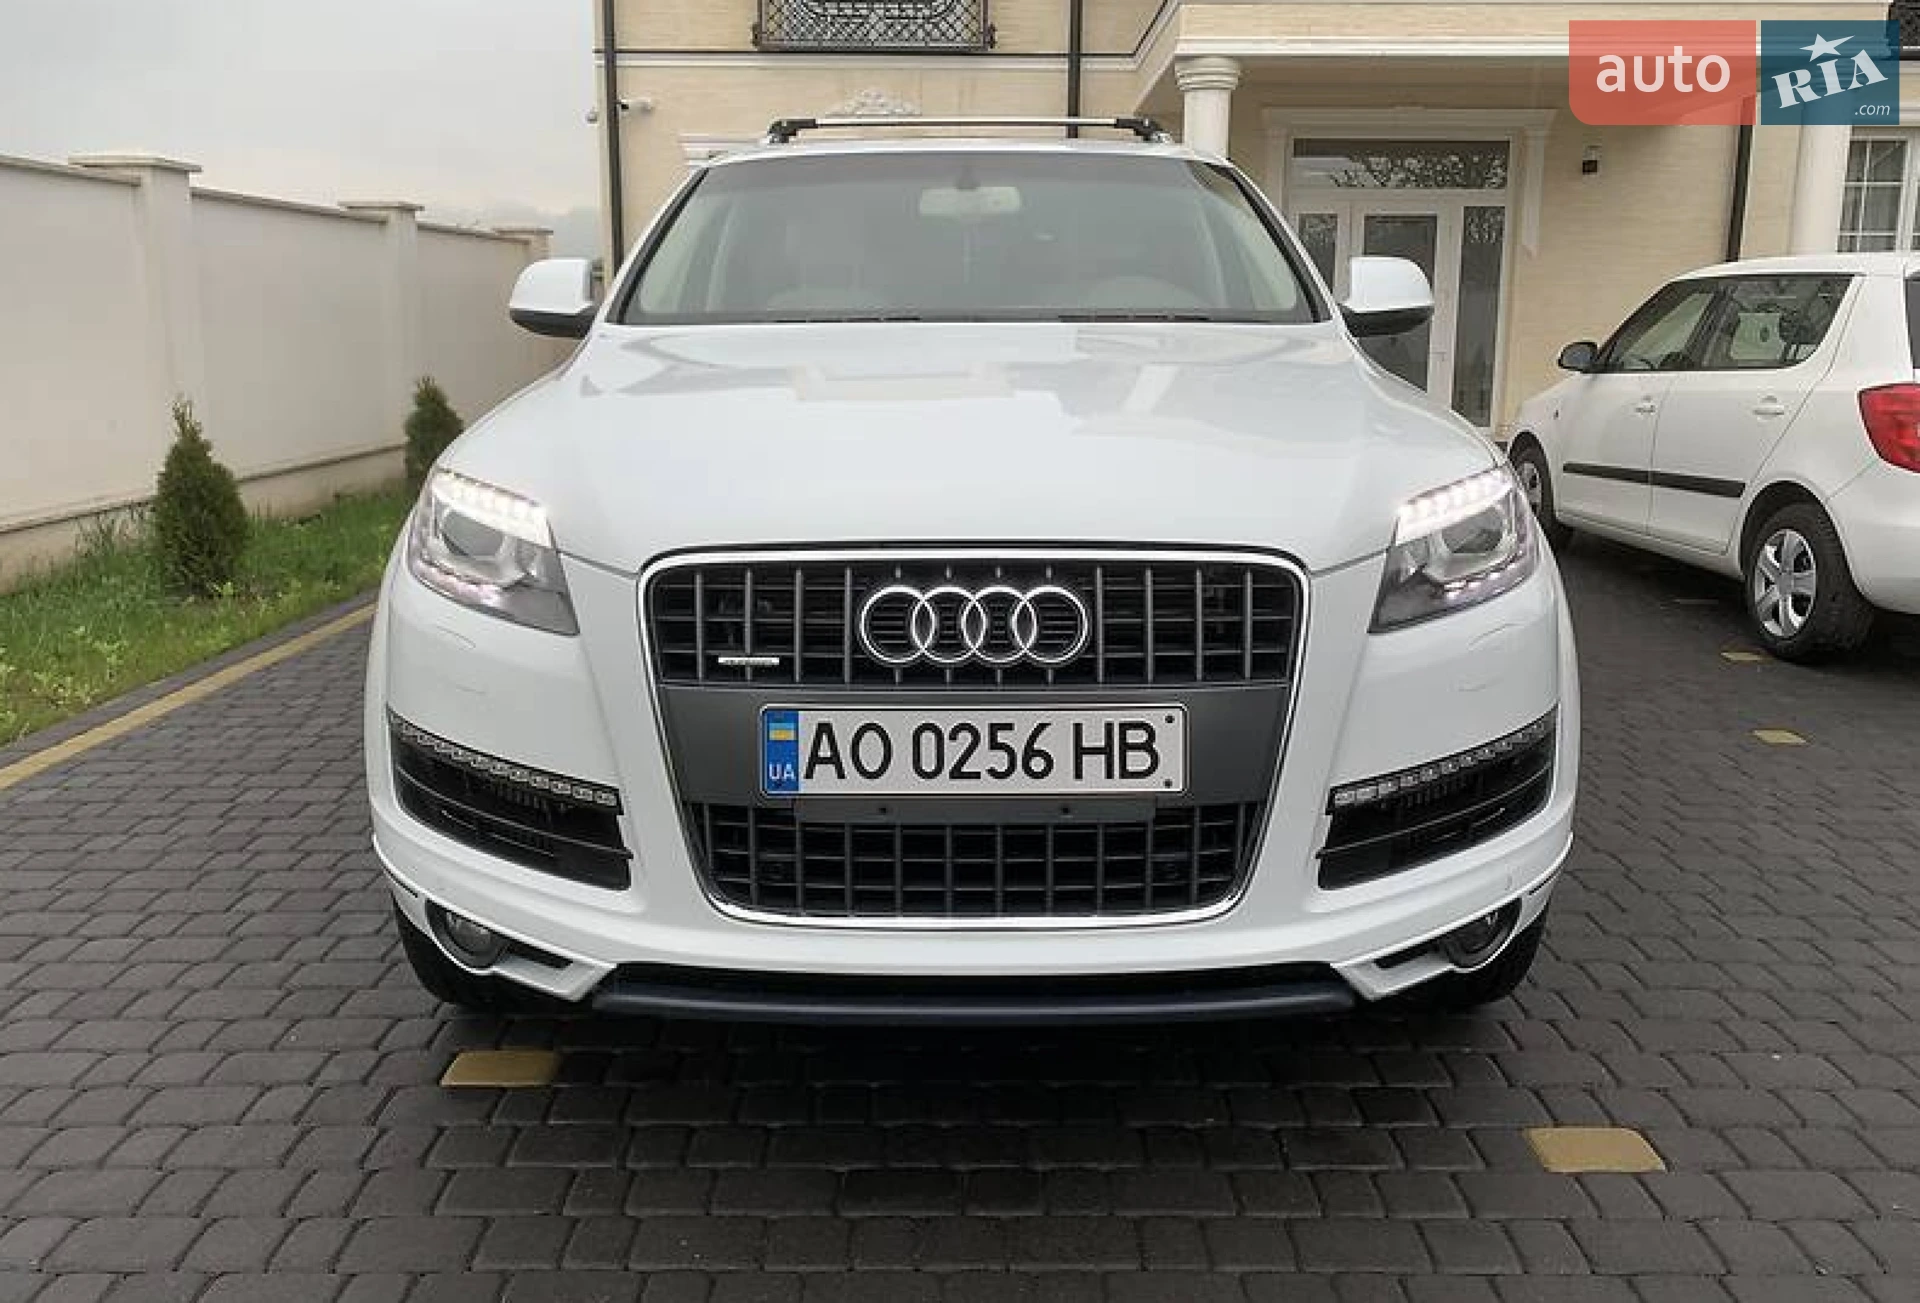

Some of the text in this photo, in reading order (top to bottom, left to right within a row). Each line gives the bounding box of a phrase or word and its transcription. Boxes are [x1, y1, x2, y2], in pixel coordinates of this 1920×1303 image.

[803, 722, 1160, 780] AO 0256 HB
[768, 763, 796, 781] UA
